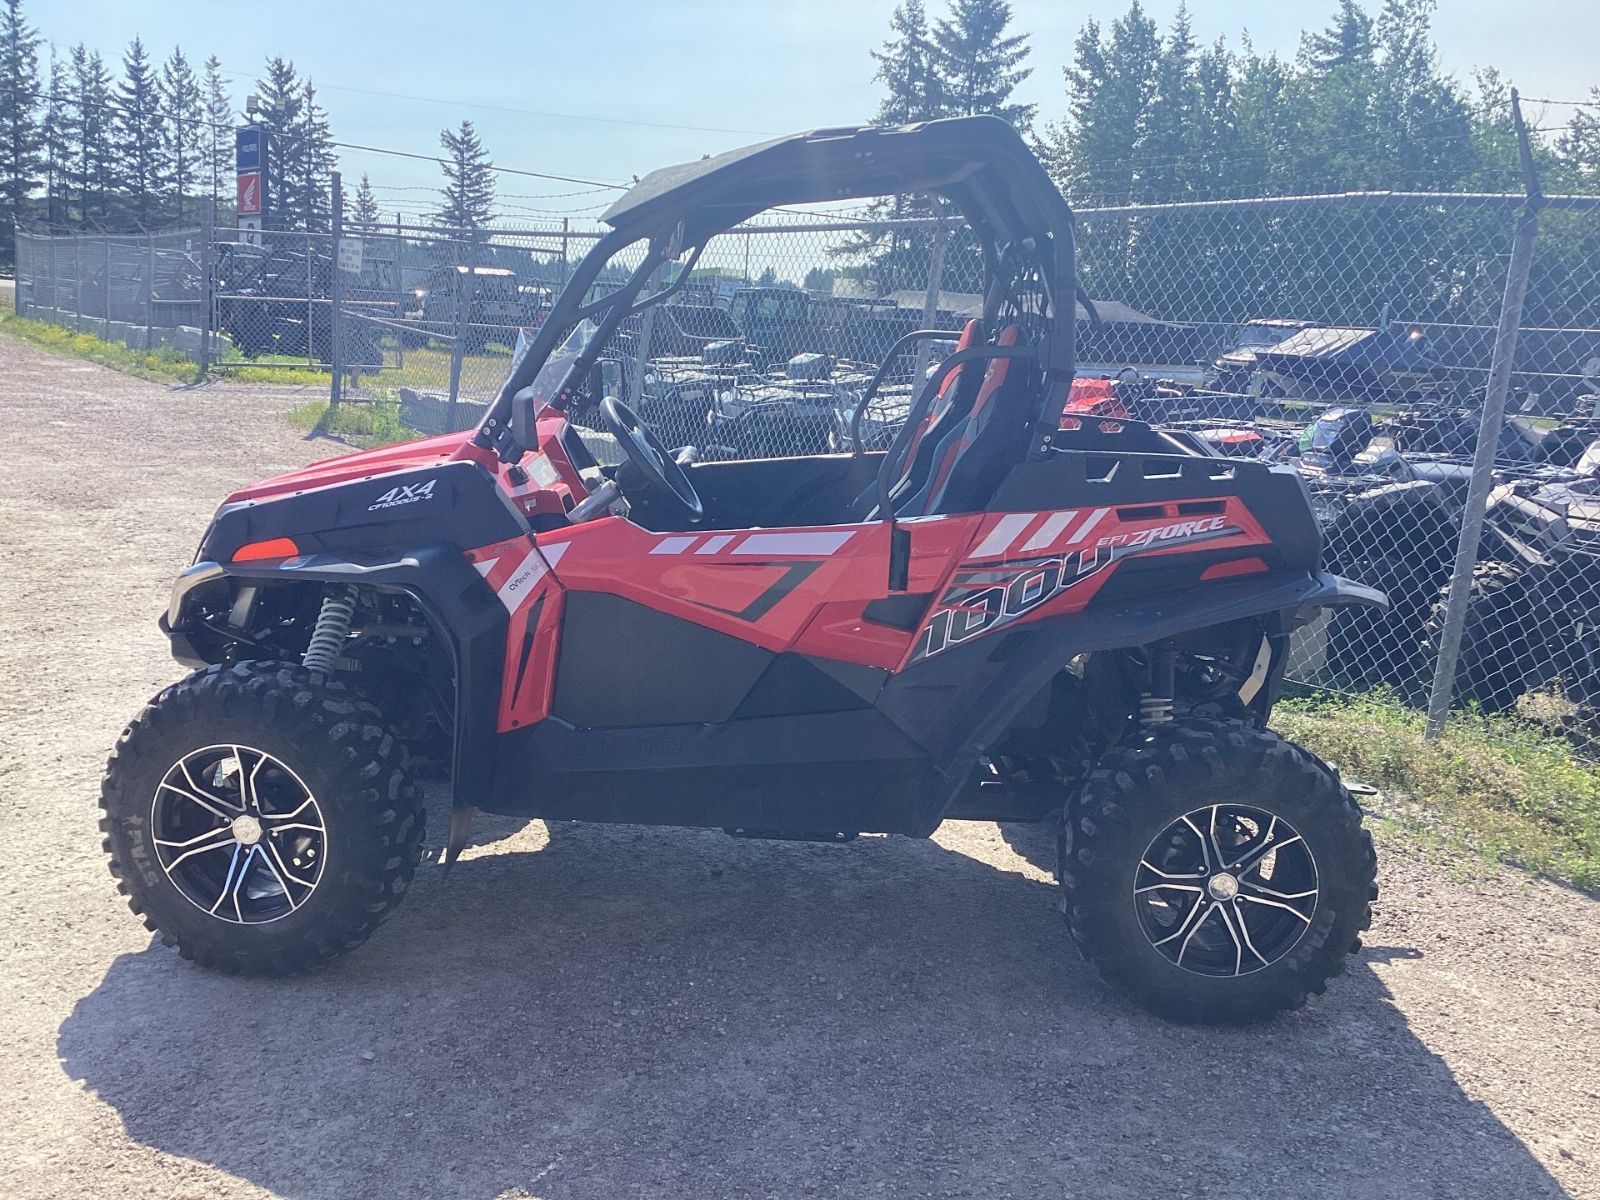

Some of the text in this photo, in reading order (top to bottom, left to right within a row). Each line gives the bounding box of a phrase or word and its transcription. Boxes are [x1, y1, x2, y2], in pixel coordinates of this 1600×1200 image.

[1096, 516, 1228, 548] EFI ZFORCE
[508, 570, 532, 591] CVTech
[924, 546, 1114, 658] 1000
